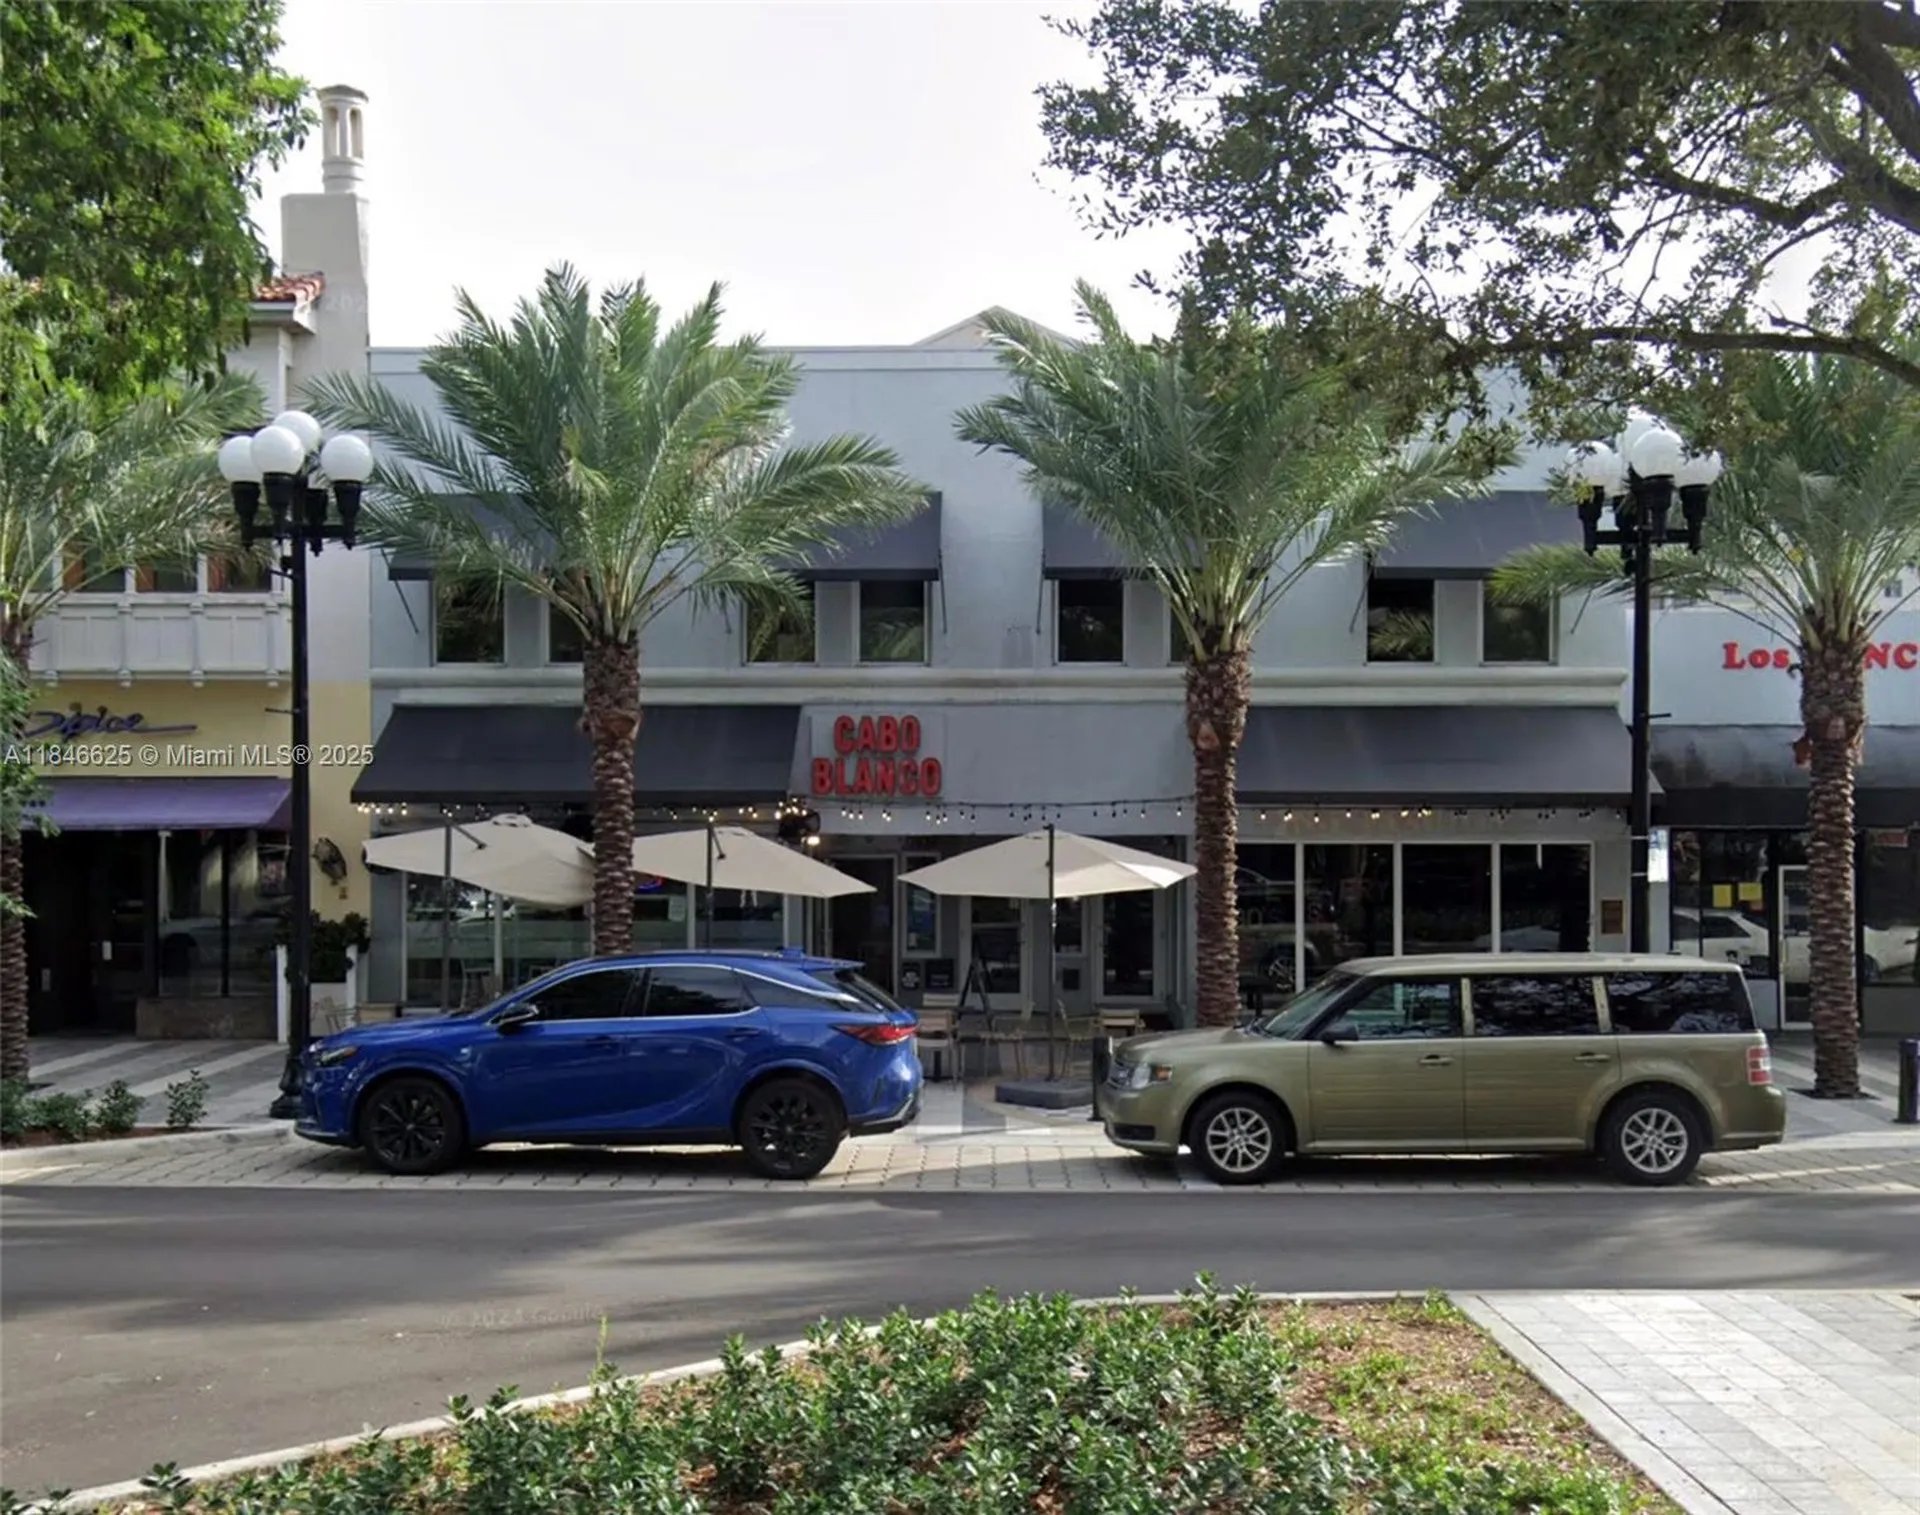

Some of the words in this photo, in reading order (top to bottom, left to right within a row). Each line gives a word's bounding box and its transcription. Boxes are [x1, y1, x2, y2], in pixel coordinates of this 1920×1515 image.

[1722, 641, 1790, 669] Los
[834, 715, 920, 753] CABO
[812, 757, 941, 797] BLANCO
